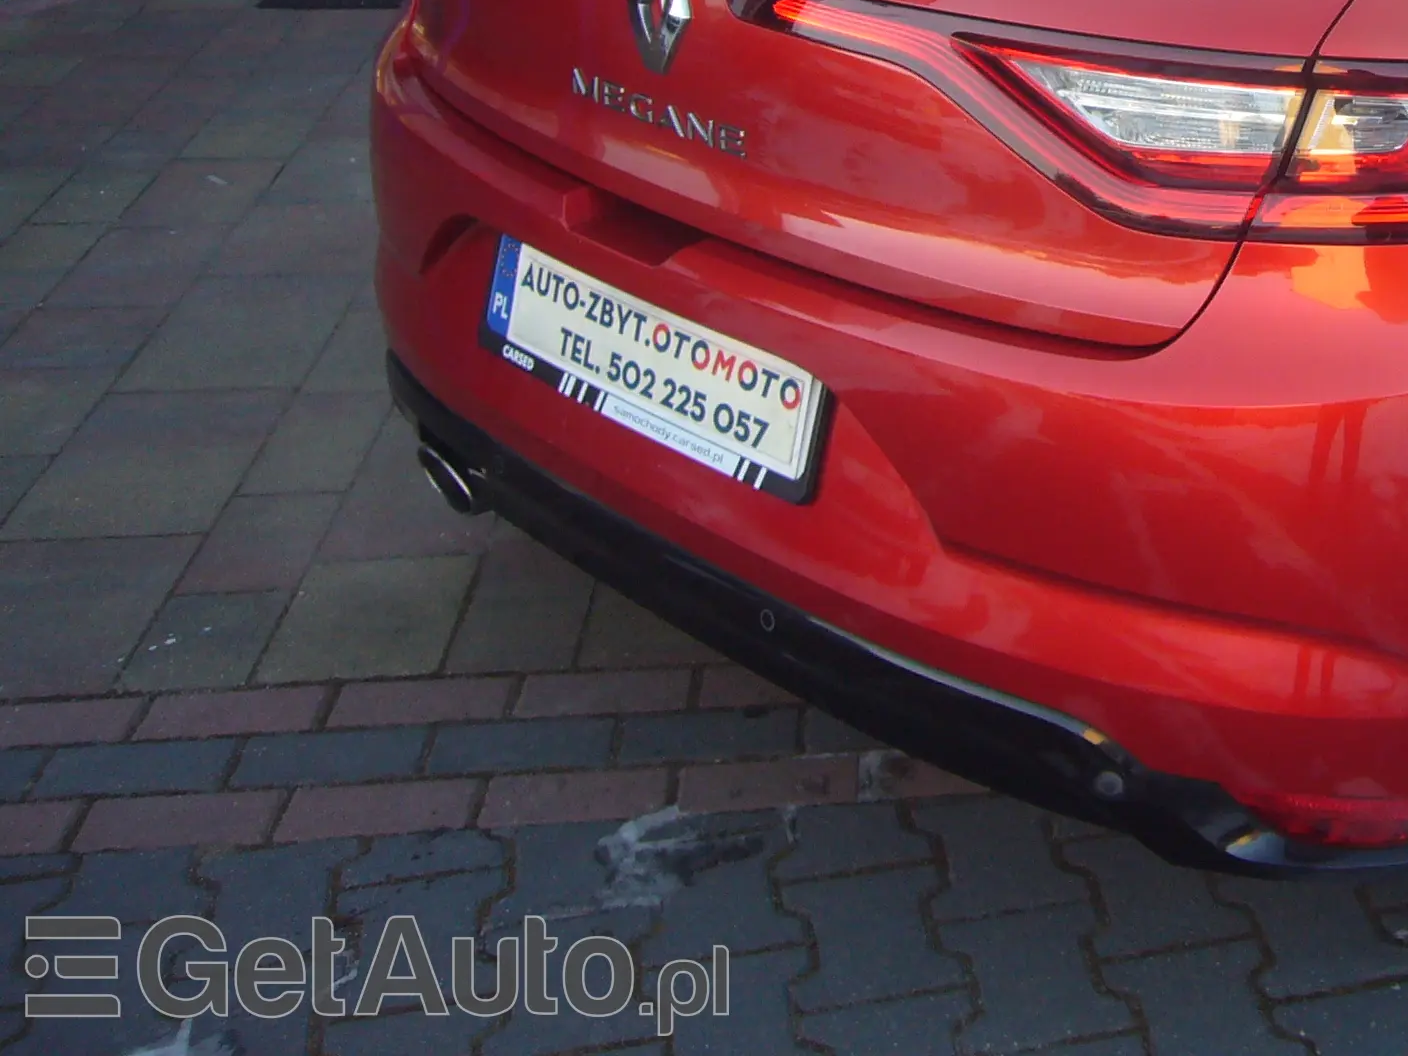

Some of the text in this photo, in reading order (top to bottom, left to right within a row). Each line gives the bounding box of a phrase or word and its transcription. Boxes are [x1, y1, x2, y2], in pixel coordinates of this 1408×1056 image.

[572, 67, 746, 158] MEGANE
[491, 291, 509, 321] PL
[521, 263, 801, 410] AUTO-ZBYT.OTOMOTO
[560, 327, 770, 449] TEL. 502 225 057
